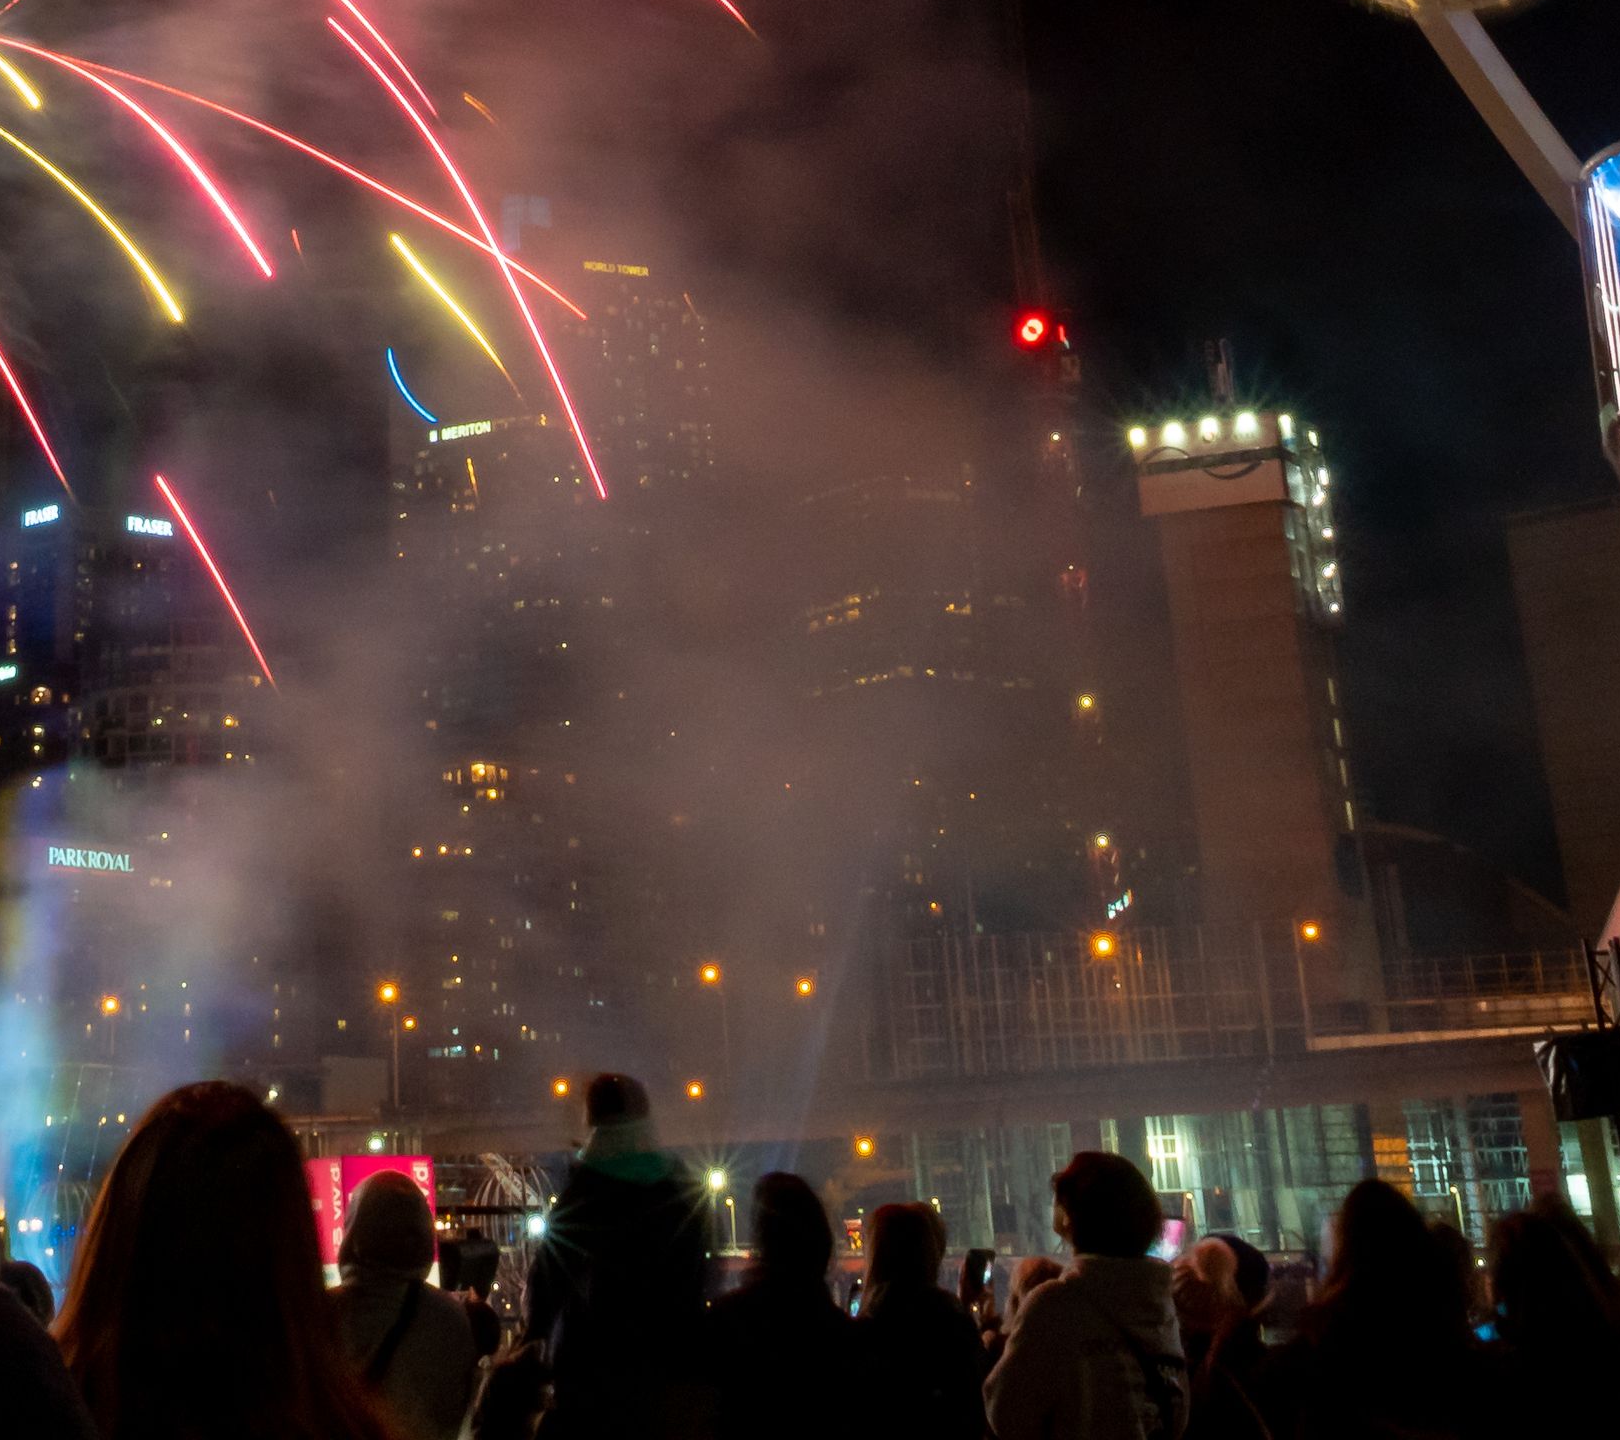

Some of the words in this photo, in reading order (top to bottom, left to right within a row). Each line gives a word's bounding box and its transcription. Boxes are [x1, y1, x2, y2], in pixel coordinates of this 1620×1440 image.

[617, 263, 649, 277] TOWER
[441, 420, 492, 441] MERITON
[24, 504, 59, 527] FRASER
[127, 516, 173, 537] FRASER
